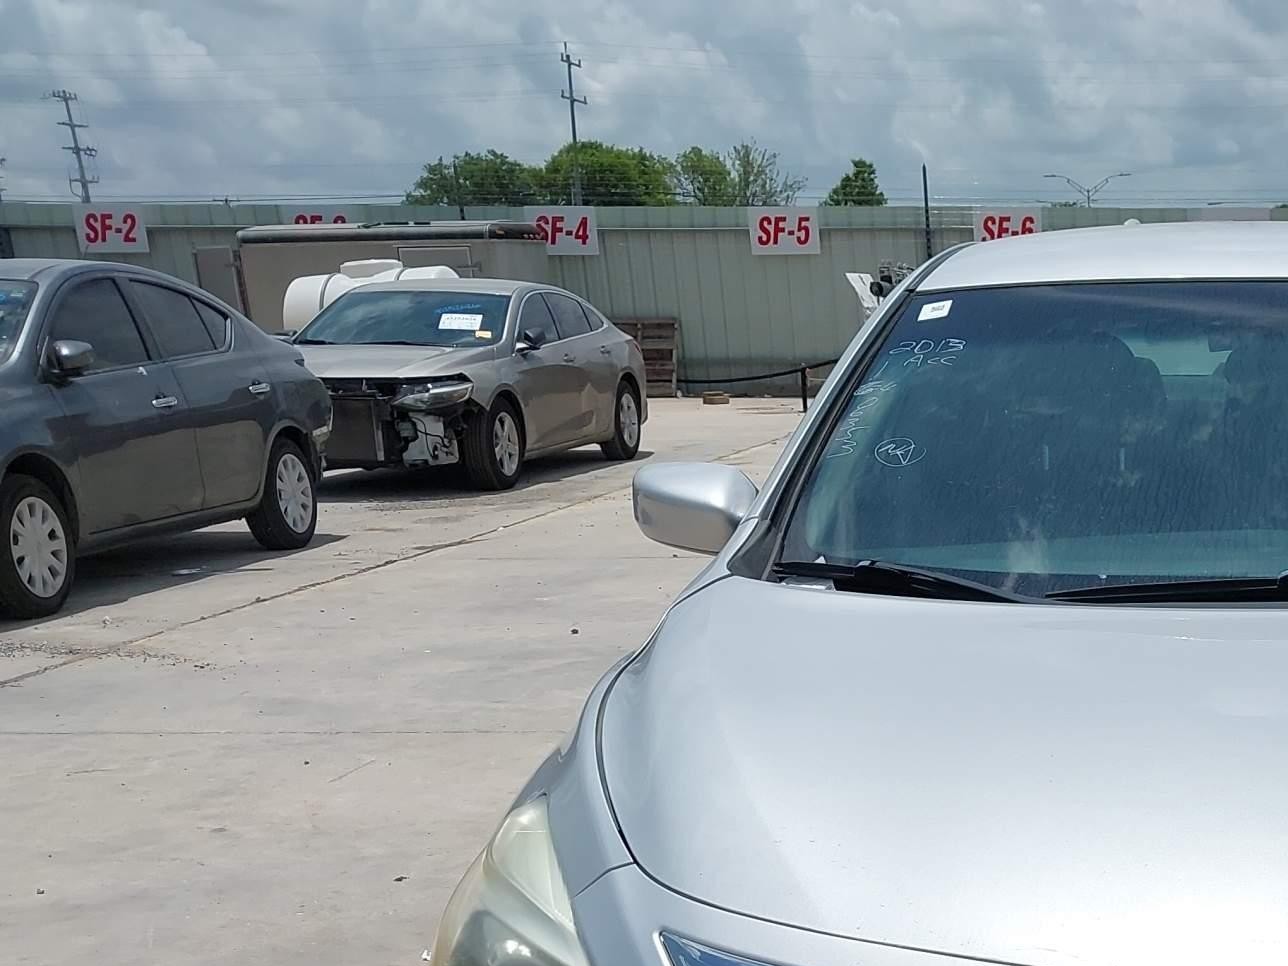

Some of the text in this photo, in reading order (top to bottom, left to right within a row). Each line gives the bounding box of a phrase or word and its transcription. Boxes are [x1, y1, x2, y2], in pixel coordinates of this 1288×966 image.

[85, 213, 137, 243] SF-2
[536, 214, 589, 245] SF-4
[757, 215, 811, 246] SF-5
[981, 215, 1035, 241] SF-6
[889, 338, 966, 354] 2013
